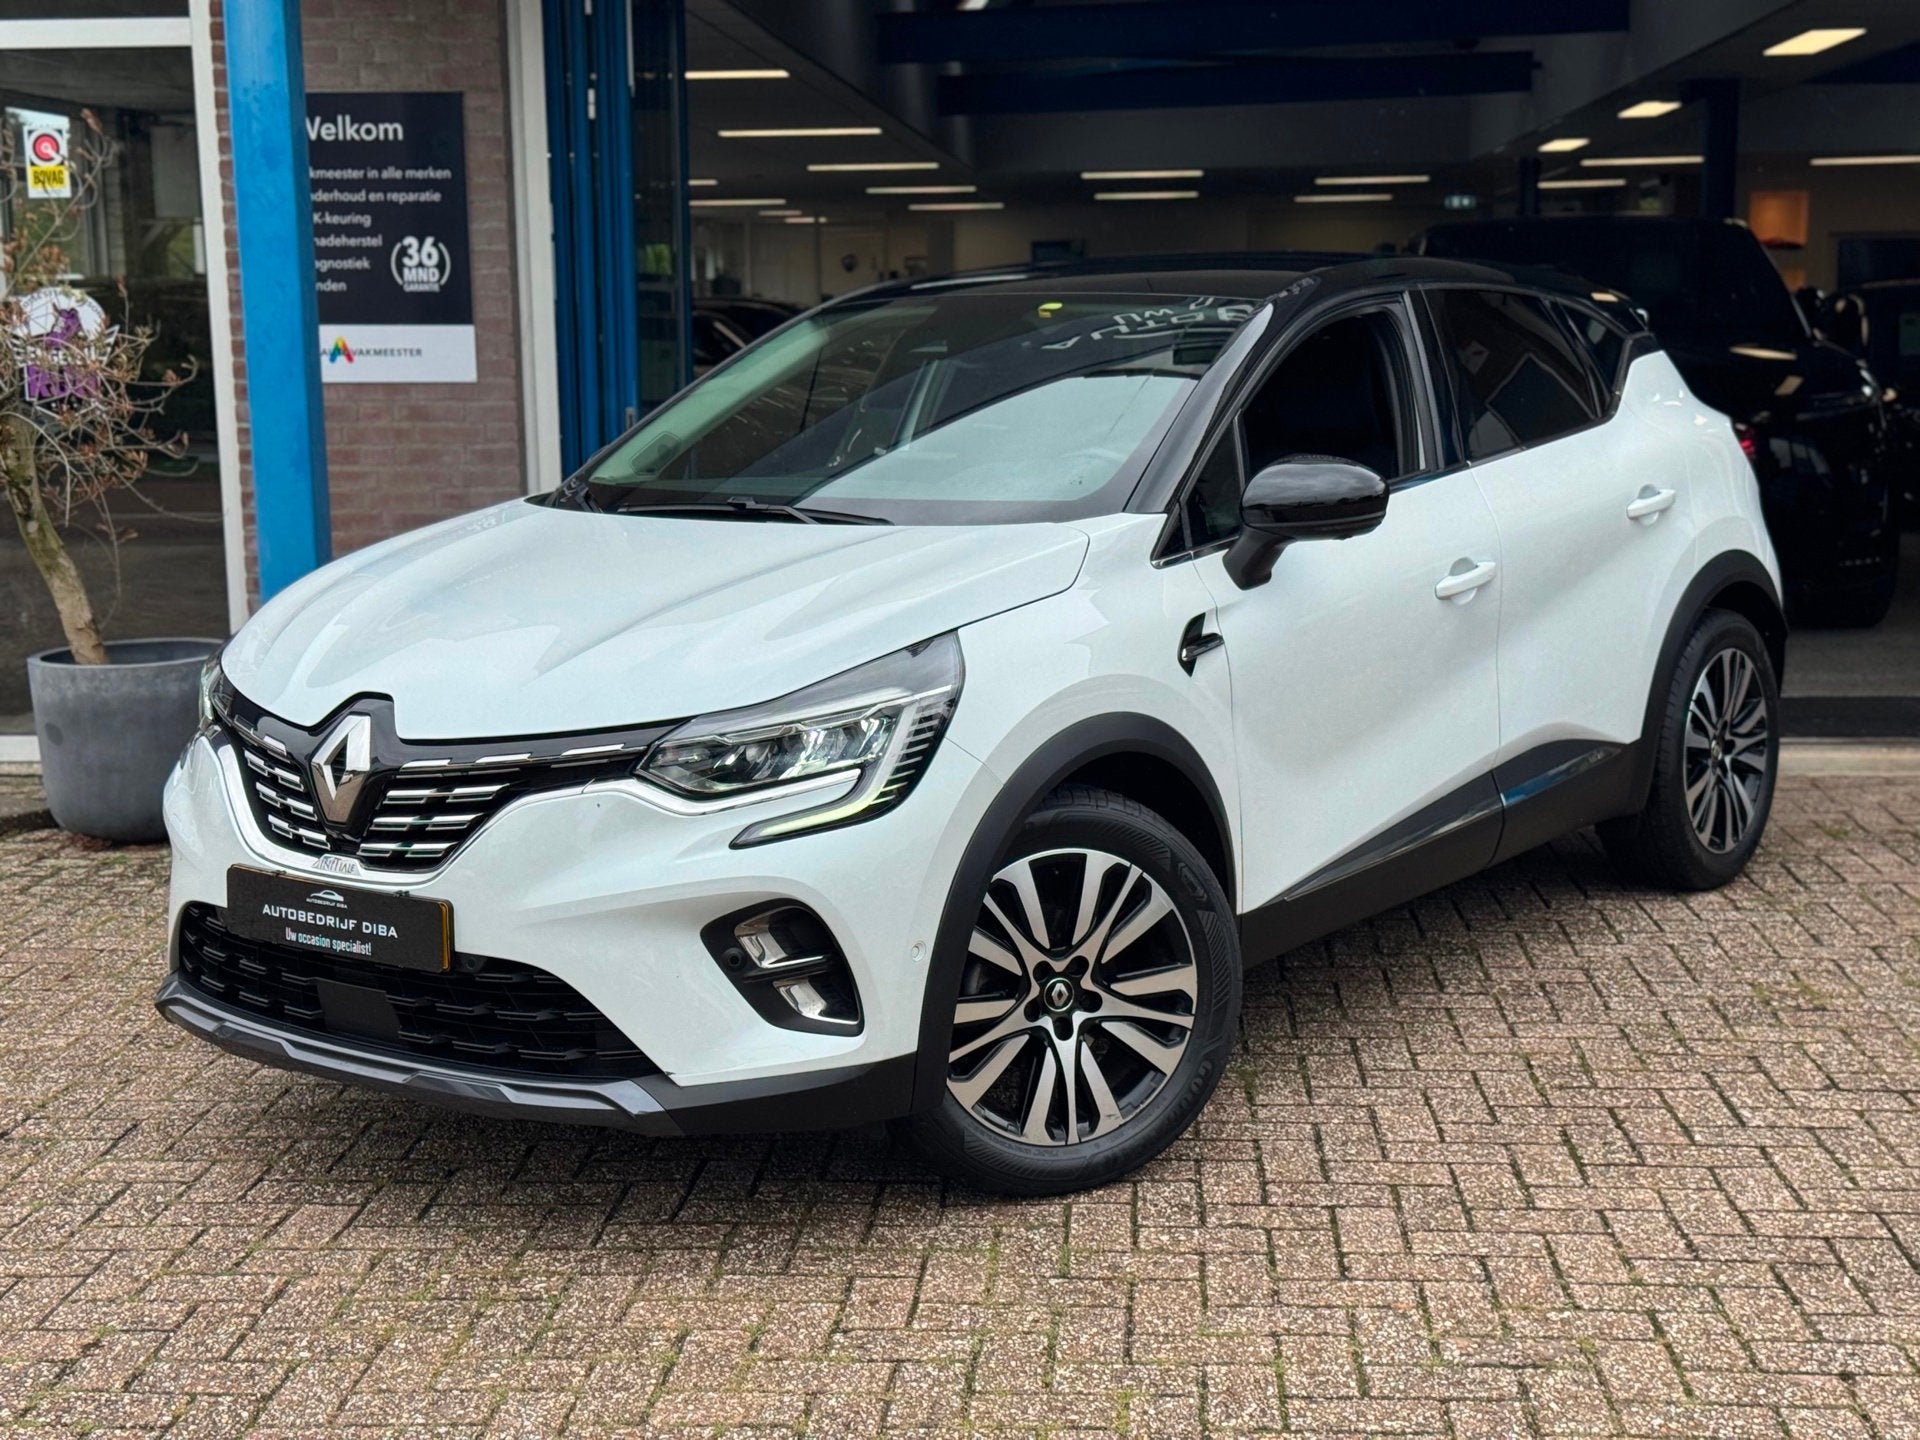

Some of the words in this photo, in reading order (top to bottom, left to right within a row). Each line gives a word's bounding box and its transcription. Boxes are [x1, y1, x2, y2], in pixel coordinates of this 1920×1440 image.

[366, 166, 379, 179] in
[381, 166, 403, 179] alle
[405, 166, 452, 179] merken
[368, 191, 385, 202] en
[386, 189, 442, 205] reparatie
[402, 235, 439, 267] 36
[403, 267, 440, 282] MND
[262, 904, 357, 931] AUTOBEDRIJF
[362, 920, 398, 939] DIBA
[285, 926, 297, 942] Uw
[298, 930, 331, 948] occasion
[332, 937, 372, 956] specialist!
